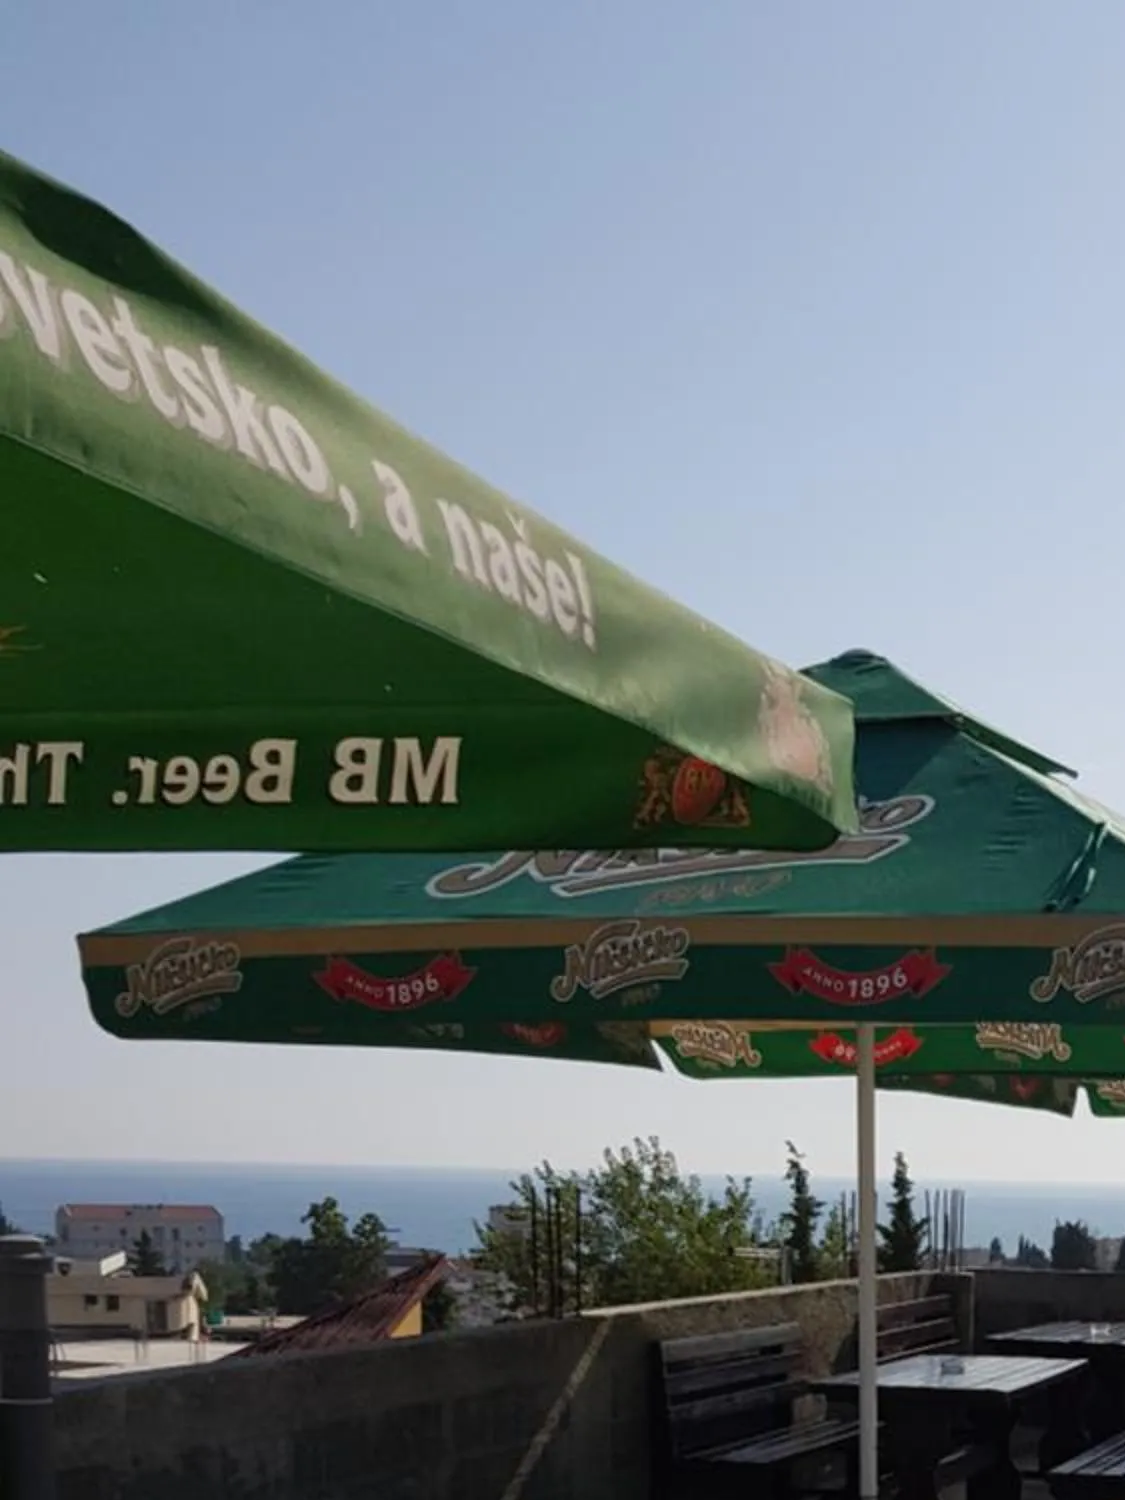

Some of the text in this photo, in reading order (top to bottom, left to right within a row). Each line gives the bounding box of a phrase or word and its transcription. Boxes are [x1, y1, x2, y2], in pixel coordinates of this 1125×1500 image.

[0, 252, 596, 653] vetsko, a naše!
[385, 971, 440, 1004] 1896
[802, 967, 908, 999] ANNO 1896
